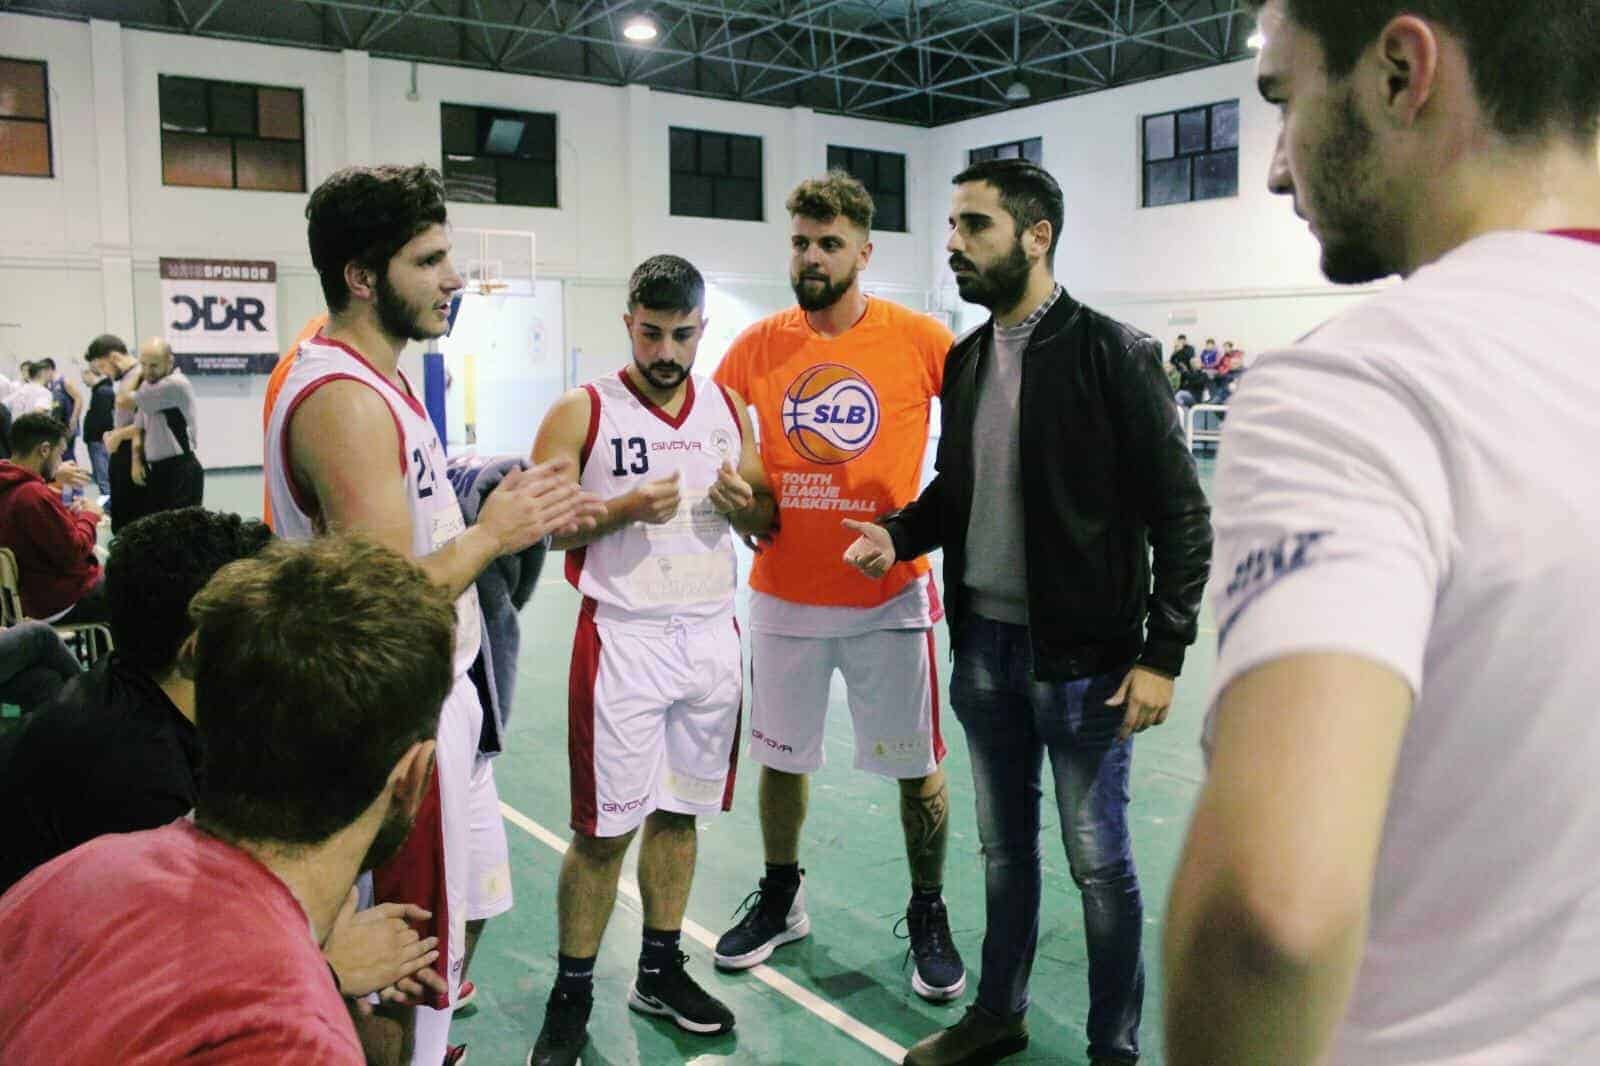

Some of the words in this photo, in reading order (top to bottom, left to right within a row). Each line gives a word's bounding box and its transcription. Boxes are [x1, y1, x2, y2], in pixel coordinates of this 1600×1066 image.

[814, 404, 866, 424] SLB
[651, 440, 702, 452] GIVOVA
[610, 437, 649, 477] 13
[782, 472, 833, 485] SOUTH
[781, 485, 841, 498] LEAGUE
[779, 497, 877, 512] BASKETBALL
